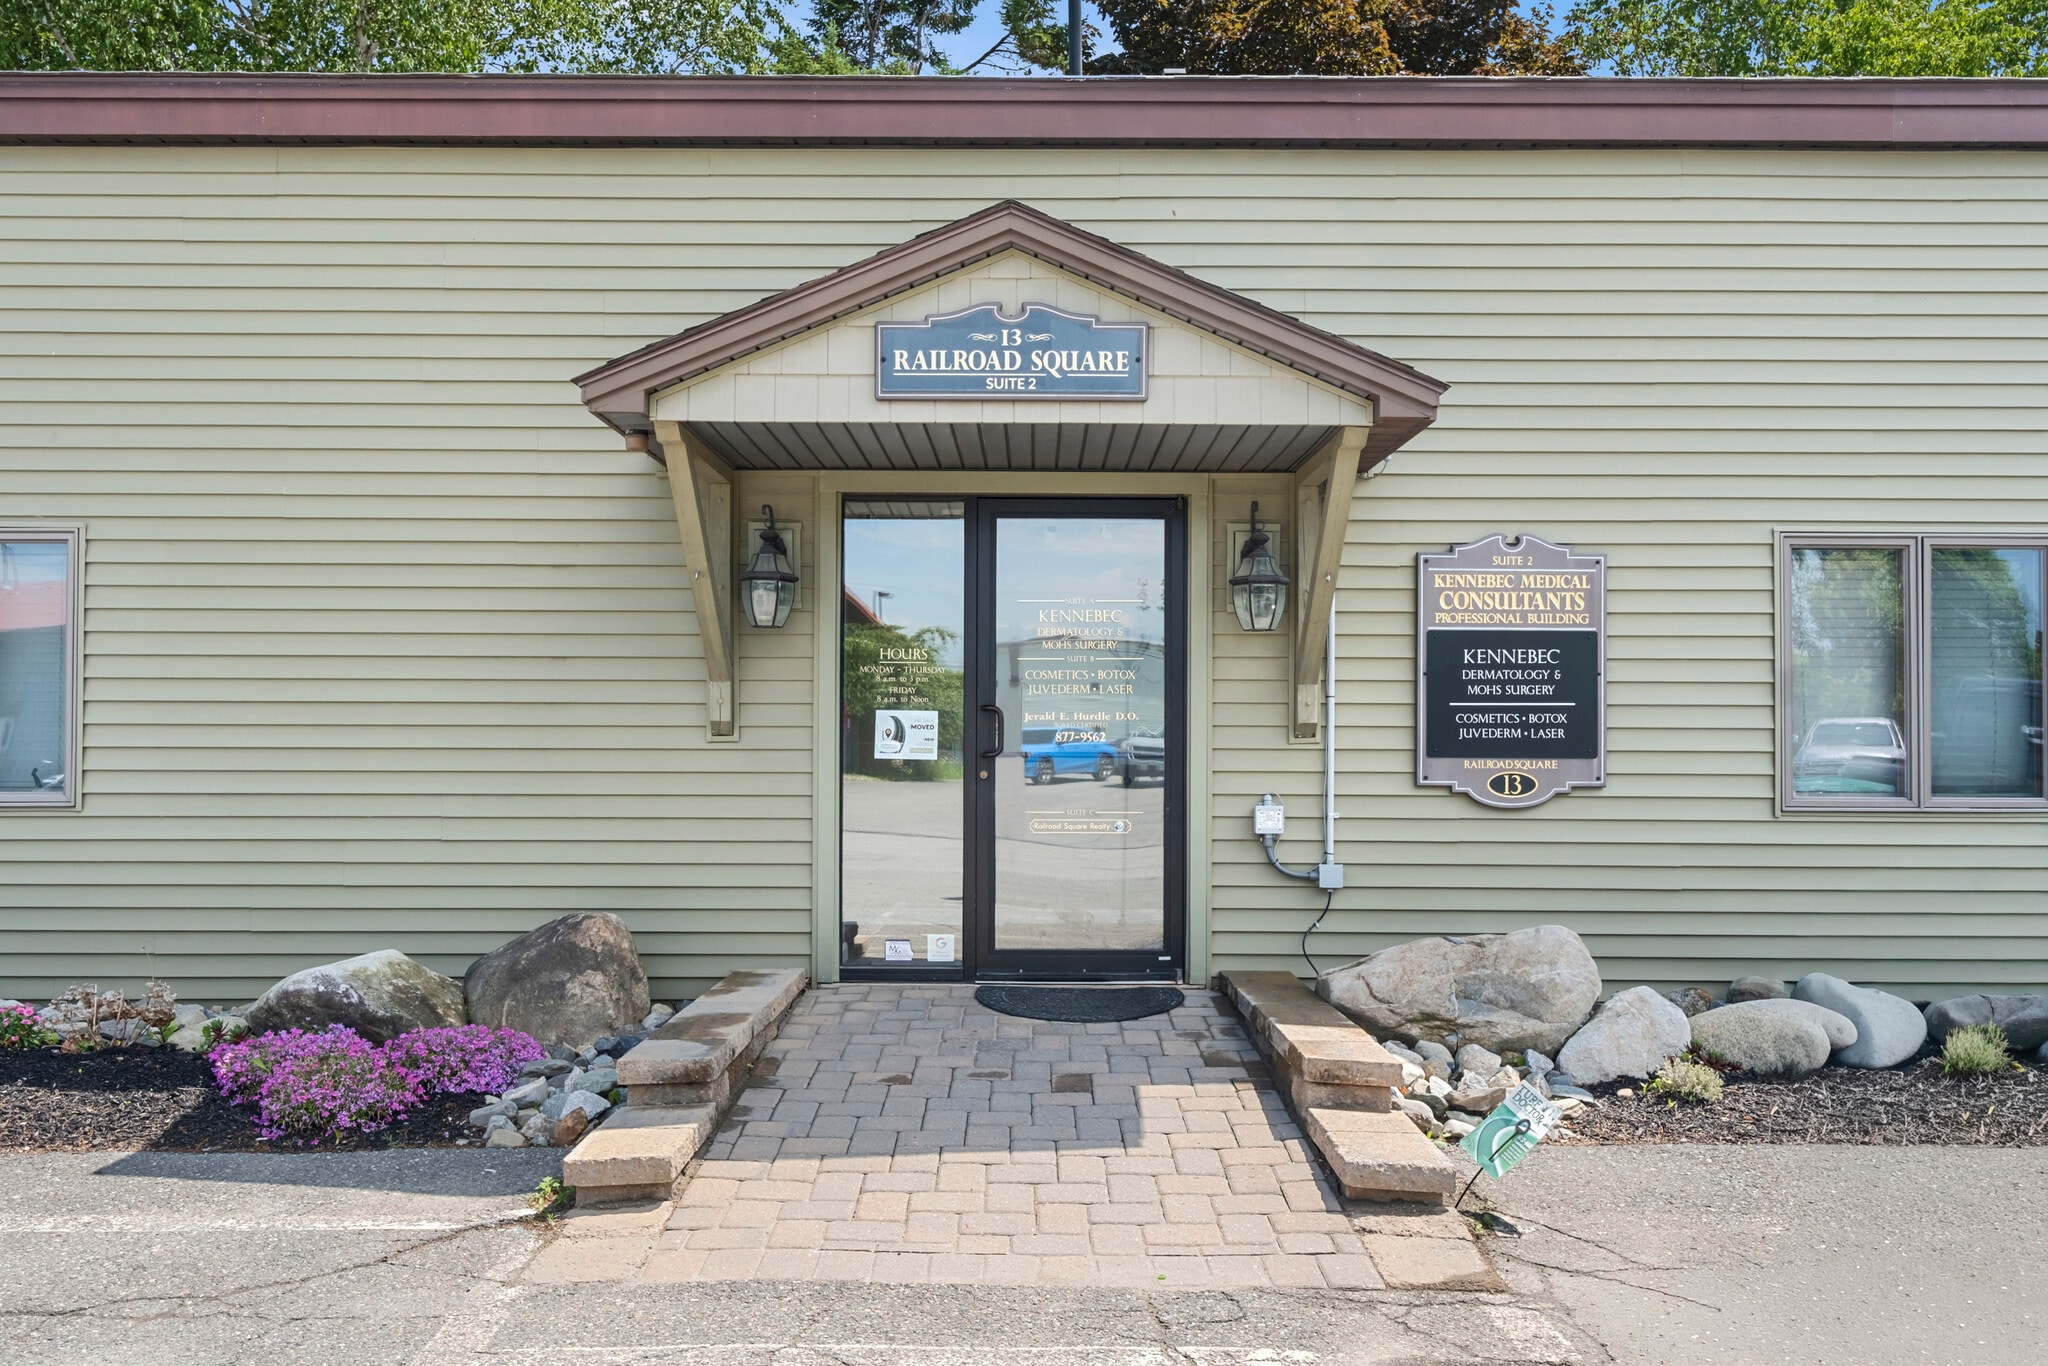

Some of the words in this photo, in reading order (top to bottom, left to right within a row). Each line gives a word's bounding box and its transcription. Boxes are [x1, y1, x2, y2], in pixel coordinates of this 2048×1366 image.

[1001, 329, 1022, 346] 13
[893, 350, 1022, 371] RAILROAD
[1031, 351, 1130, 378] SQUARE
[986, 377, 1025, 390] SUITE
[1028, 377, 1036, 390] 2
[1492, 556, 1523, 566] SUITE
[1527, 556, 1534, 566] 2
[1433, 573, 1515, 588] KENNEBEC
[1520, 574, 1591, 589] MEDICAL
[1064, 597, 1087, 605] SUITE
[1439, 591, 1585, 611] CONSULTANTS
[1039, 609, 1122, 623] KENNEBEC
[1434, 612, 1523, 624] PROFESSIONAL
[1527, 613, 1590, 625] BUILDING
[1037, 627, 1113, 637] DERMATOLOGY
[1117, 627, 1123, 637] &
[1042, 640, 1072, 650] MOHS
[1075, 640, 1118, 650] SURGERY
[879, 648, 928, 660] HOURS
[1463, 649, 1561, 664] KENNEBEC
[859, 665, 895, 673] MONDAY
[904, 665, 946, 674] THURSDAY
[1024, 669, 1089, 680] COSMETICS
[1097, 669, 1136, 680] BOTOX
[1462, 670, 1550, 680] DERMATOLOGY
[1554, 670, 1561, 680] &
[889, 686, 917, 694] FRIDAY
[1028, 684, 1090, 695] JUVEDERM
[1099, 684, 1134, 695] LASER
[1467, 685, 1502, 695] MOHS
[1505, 685, 1556, 695] SURGERY
[910, 695, 929, 703] Noon
[1024, 712, 1055, 723] Jerald
[1059, 712, 1069, 721] E.
[1073, 712, 1111, 721] Hurdle
[1115, 712, 1139, 721] D.O.
[1455, 713, 1520, 724] COSMETICS
[1528, 713, 1568, 724] BOTOX
[1055, 731, 1107, 743] 877-9562
[1458, 728, 1522, 740] JUVEDERM
[1531, 728, 1566, 739] LASER
[1503, 774, 1522, 795] 13
[1065, 808, 1087, 816] SUITE
[1033, 822, 1062, 830] Railroad
[1063, 822, 1088, 831] Square
[1089, 822, 1111, 831] Realty
[1520, 1084, 1544, 1107] TURF
